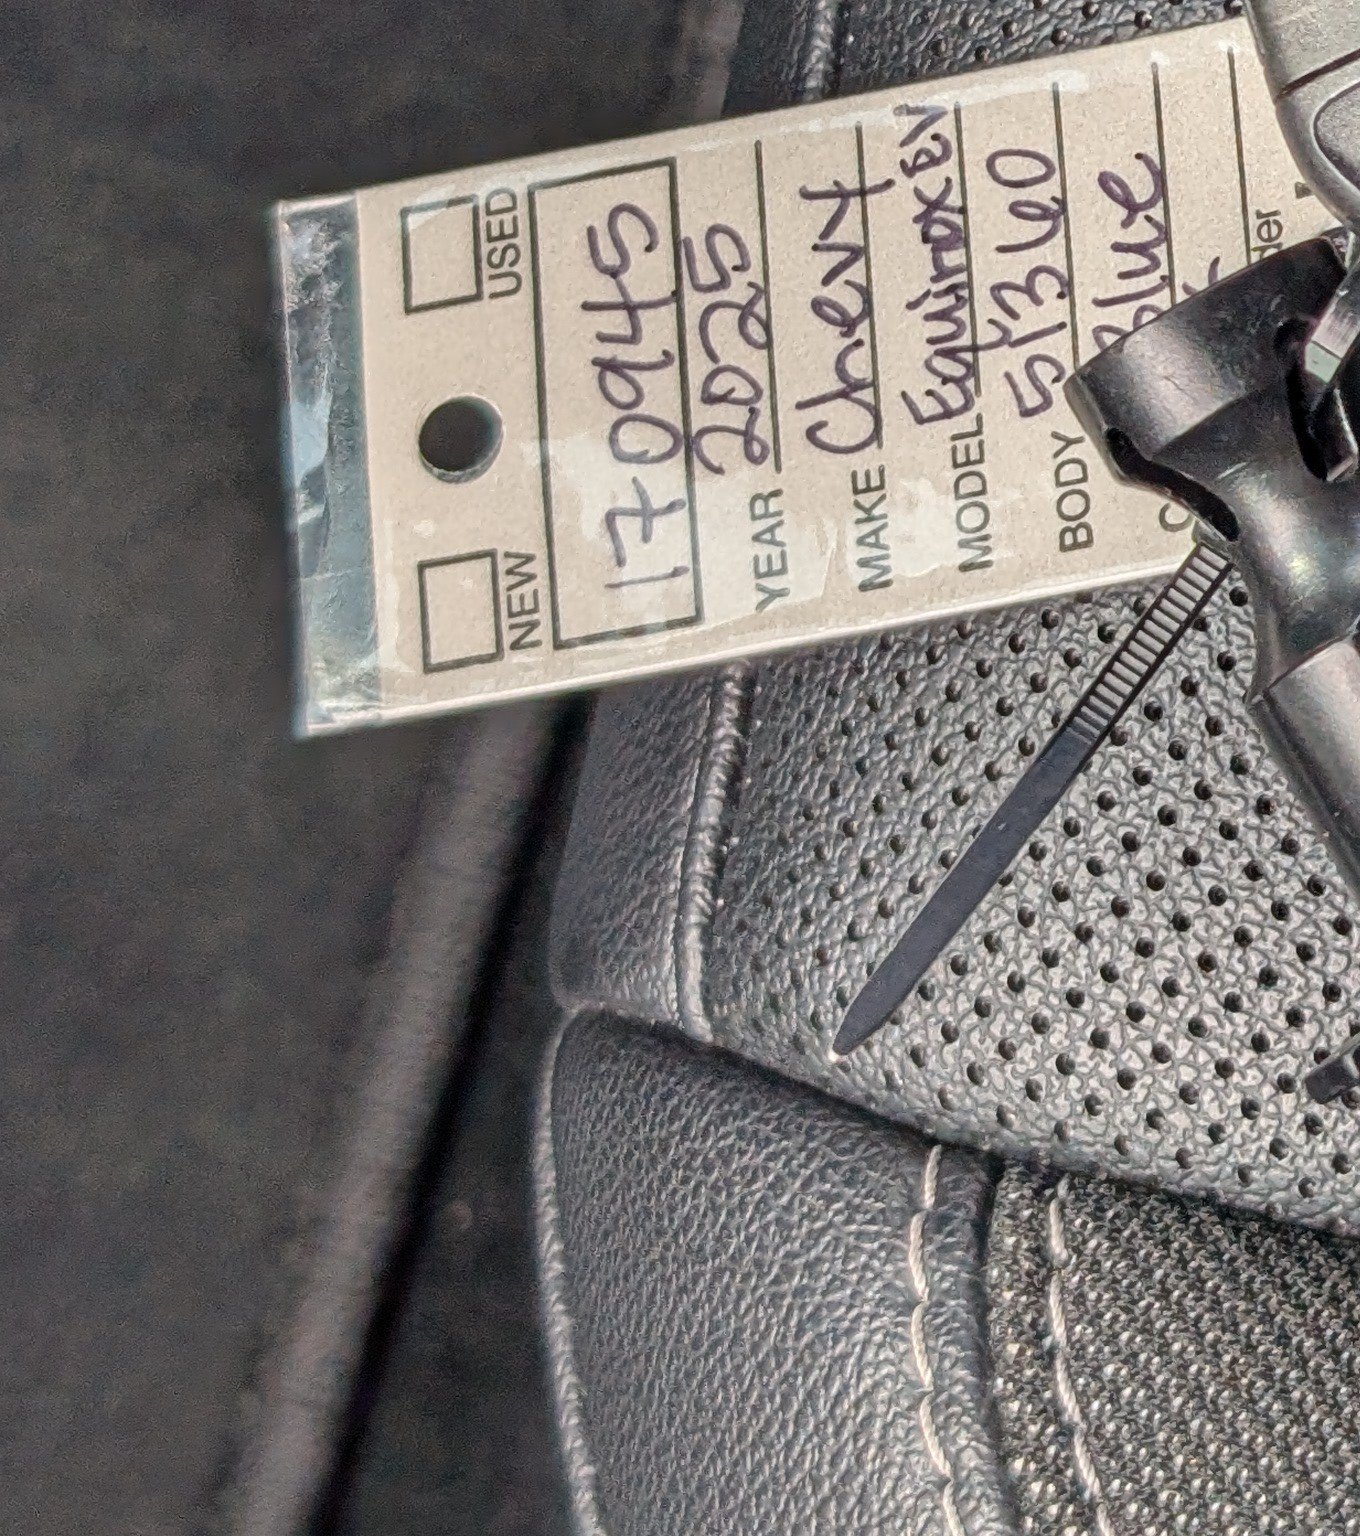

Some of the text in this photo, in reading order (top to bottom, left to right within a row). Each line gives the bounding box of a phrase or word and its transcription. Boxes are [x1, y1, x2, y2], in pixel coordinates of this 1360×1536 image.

[485, 187, 524, 300] USED
[795, 177, 896, 455] Chevy
[985, 148, 1069, 418] 51360
[581, 202, 691, 591] 170945
[682, 223, 772, 475] 2025
[748, 487, 792, 613] YEAR
[850, 464, 894, 593] MAKE
[949, 412, 995, 573] MODEL
[1049, 430, 1095, 554] BODY
[505, 550, 544, 652] NEW
